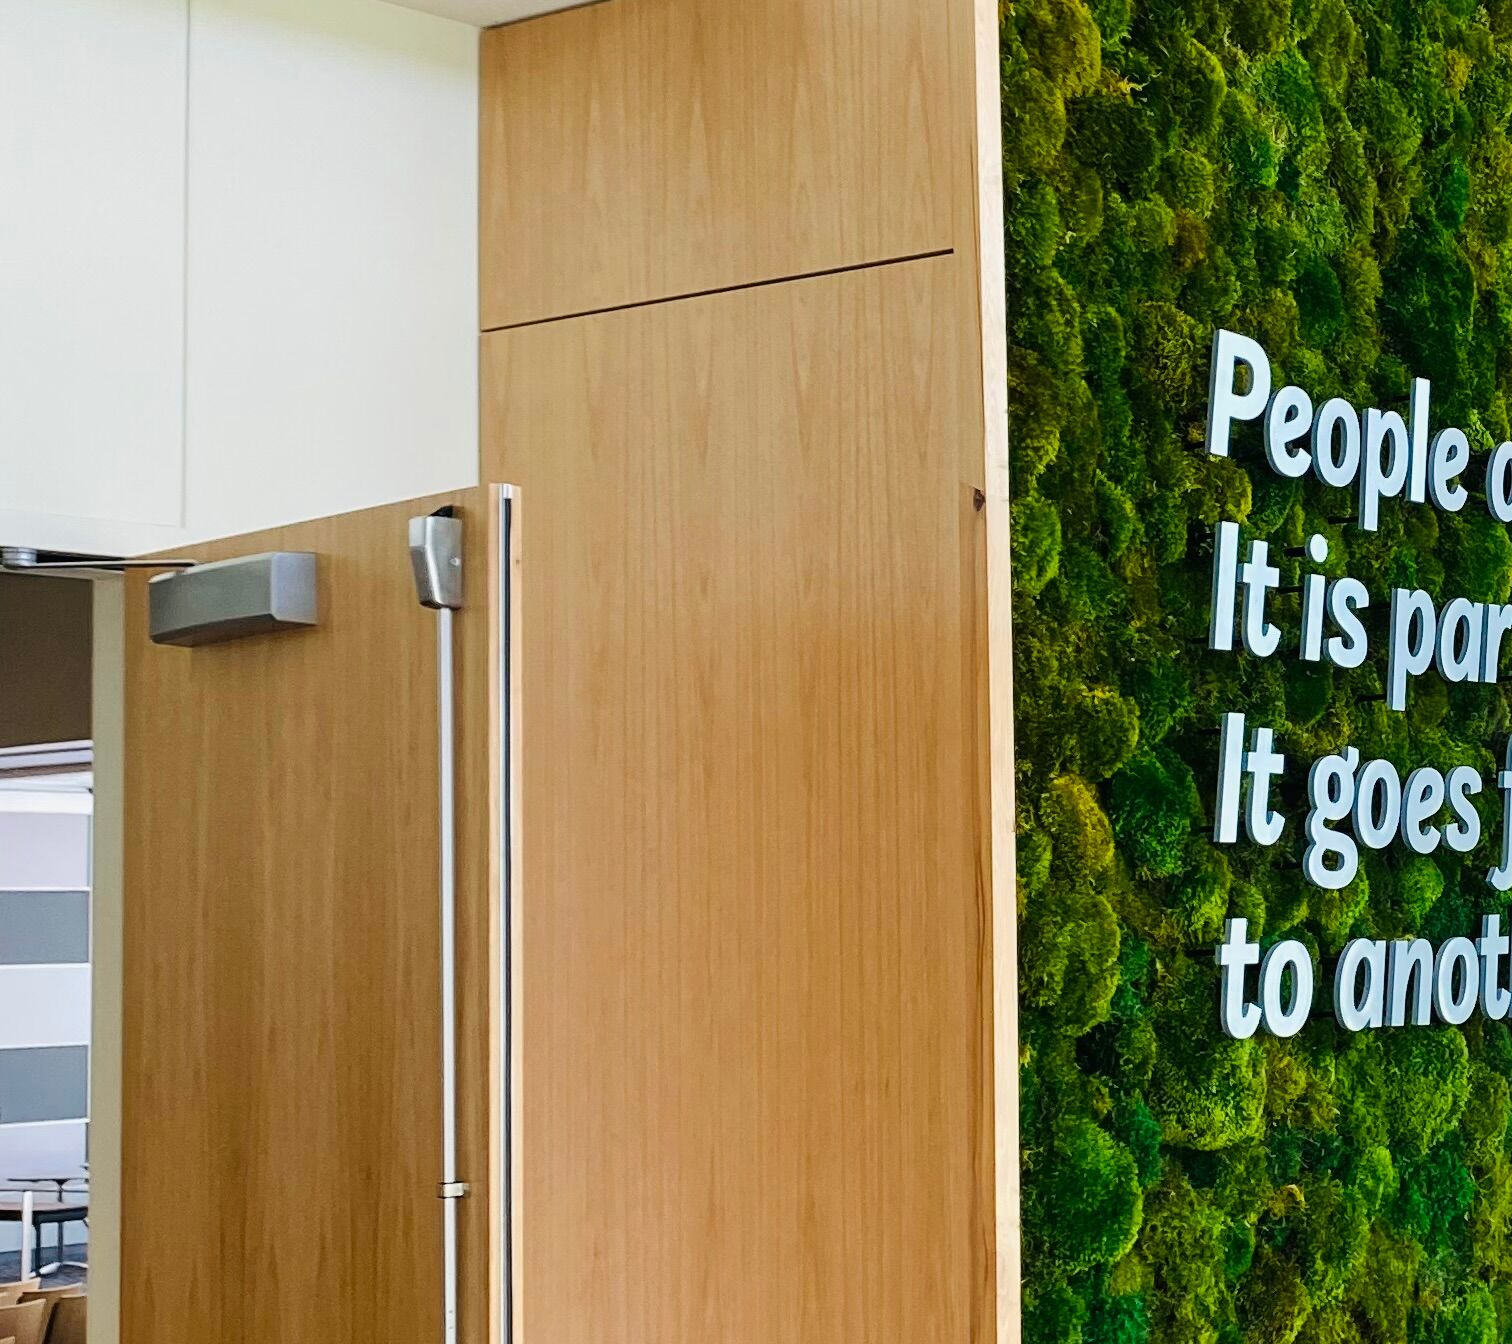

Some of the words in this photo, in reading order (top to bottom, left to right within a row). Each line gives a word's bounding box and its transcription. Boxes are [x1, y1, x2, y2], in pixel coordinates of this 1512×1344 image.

[1205, 329, 1470, 531] People
[1209, 522, 1282, 657] It
[1300, 534, 1370, 668] is
[1214, 712, 1285, 846] It
[1303, 746, 1482, 889] goes
[1217, 918, 1314, 1040] to
